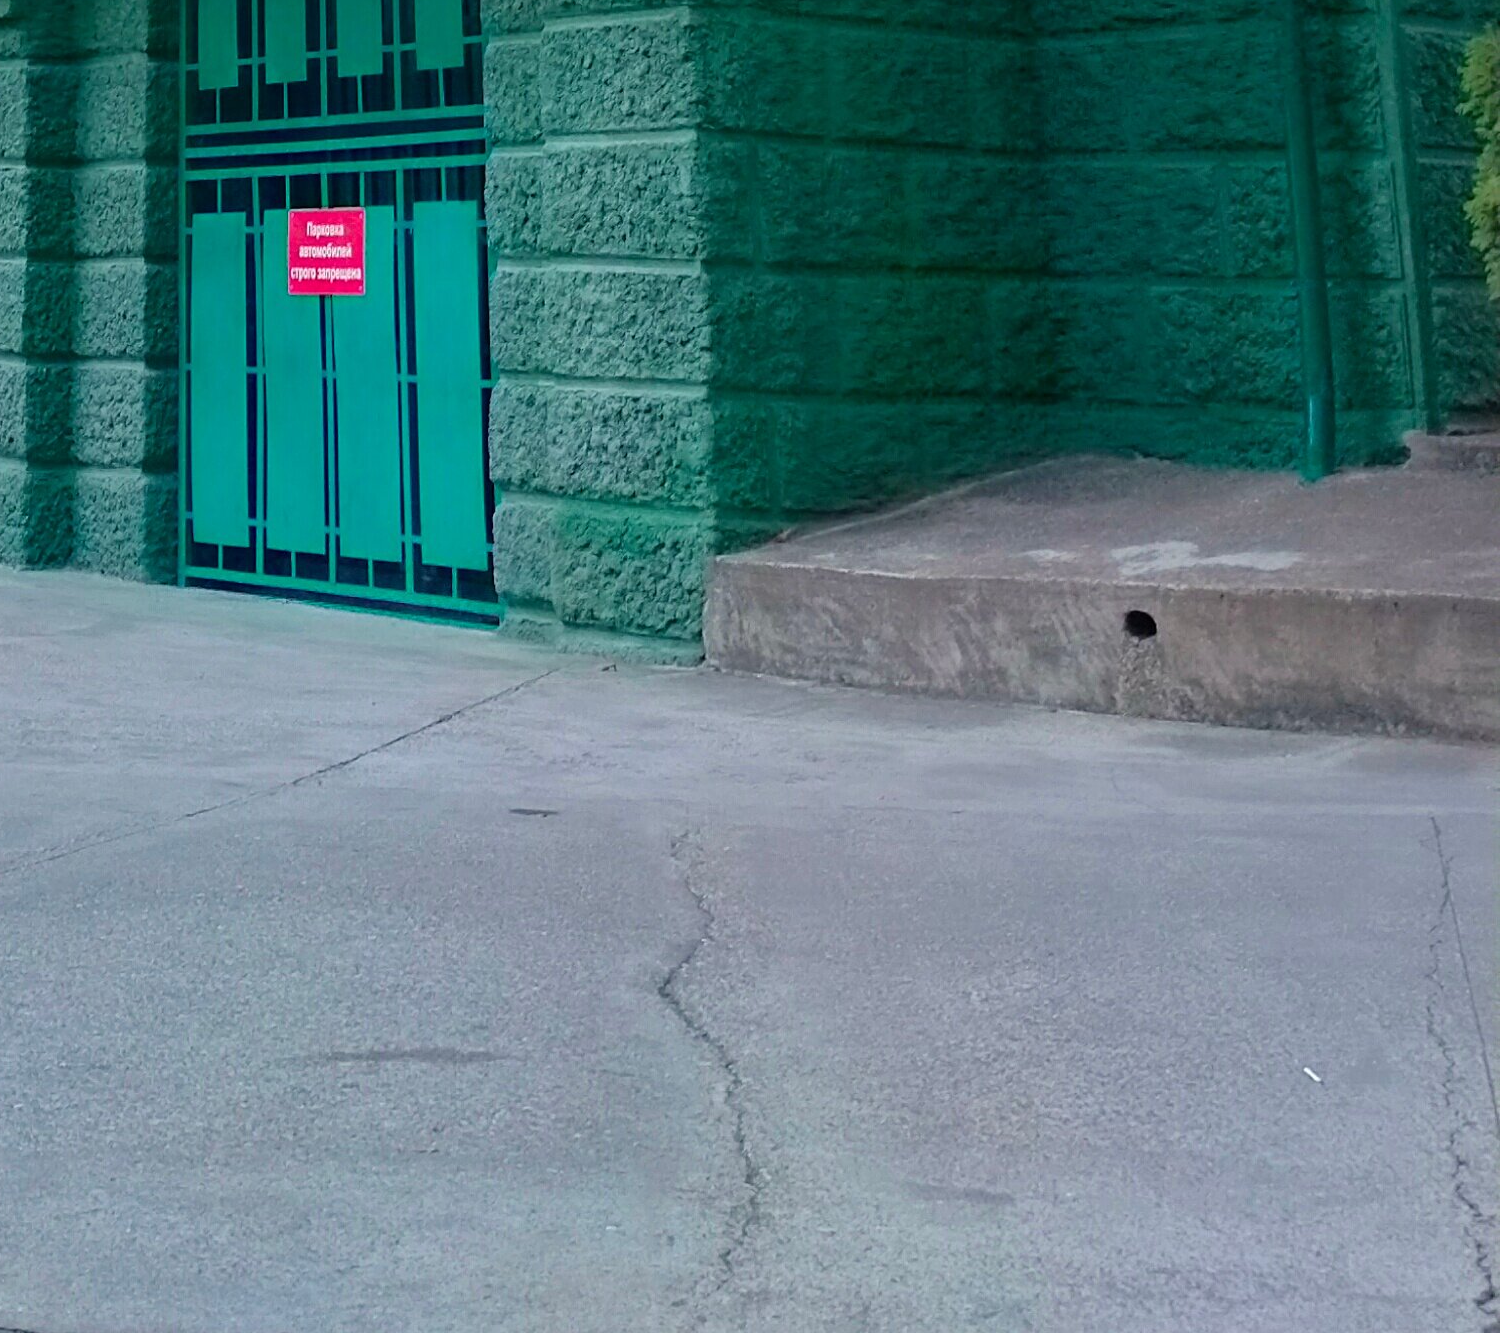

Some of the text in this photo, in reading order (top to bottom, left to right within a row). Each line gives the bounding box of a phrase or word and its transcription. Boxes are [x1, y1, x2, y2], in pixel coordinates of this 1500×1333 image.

[306, 221, 344, 240] Парковка
[298, 242, 353, 259] автомобилей
[290, 266, 362, 284] строго запрещена
